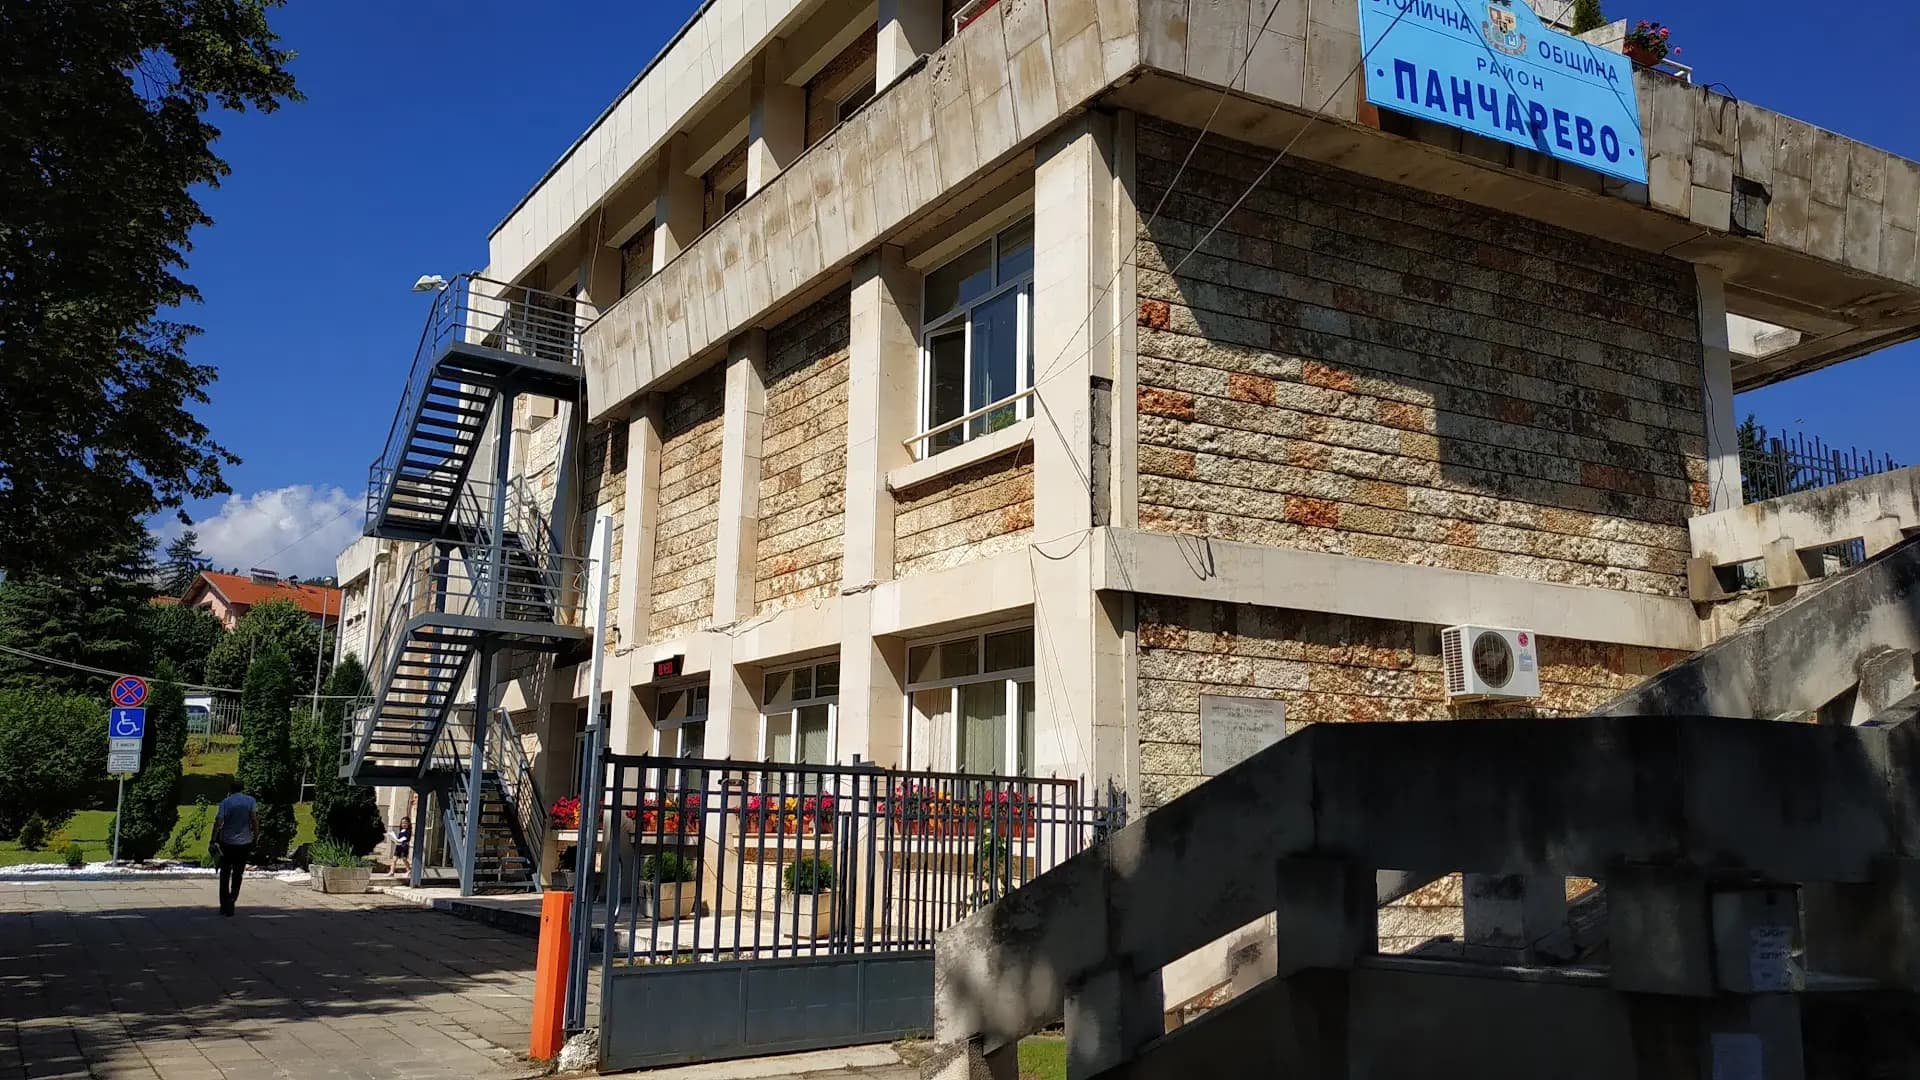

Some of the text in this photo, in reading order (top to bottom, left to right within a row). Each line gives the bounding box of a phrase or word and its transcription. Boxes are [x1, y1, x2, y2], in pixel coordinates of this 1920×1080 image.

[1373, 0, 1619, 84] ОЛИЧНА ОБЩИНА
[1476, 56, 1544, 92] РАЙОН
[1393, 57, 1621, 164] ПАНЧАРЕВО
